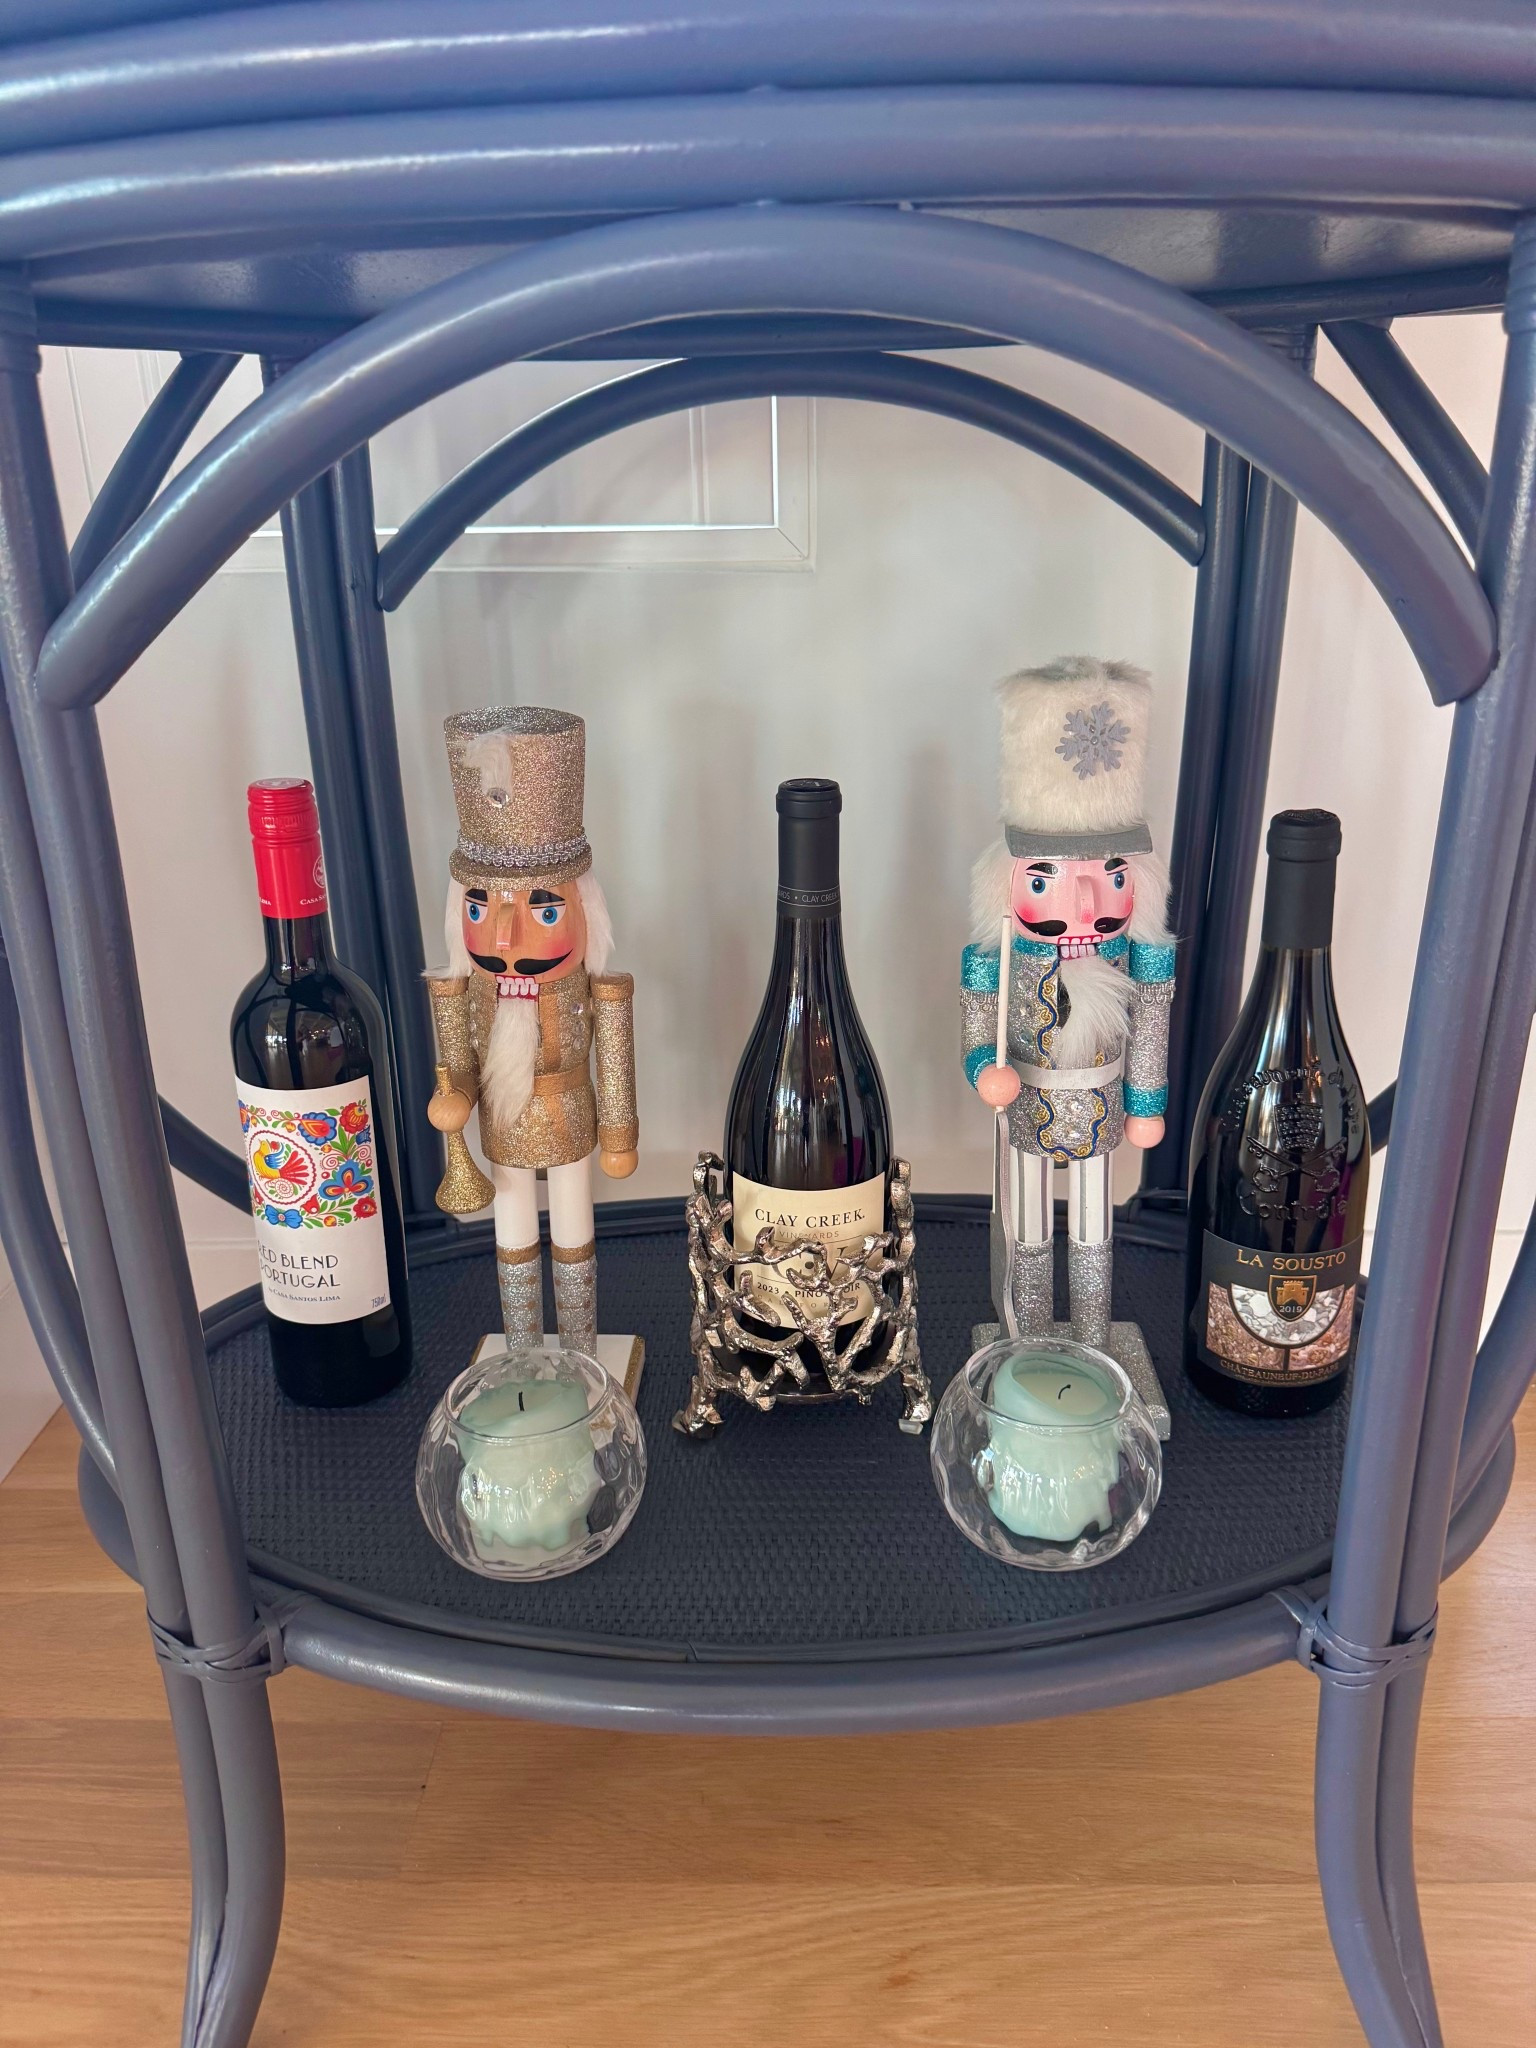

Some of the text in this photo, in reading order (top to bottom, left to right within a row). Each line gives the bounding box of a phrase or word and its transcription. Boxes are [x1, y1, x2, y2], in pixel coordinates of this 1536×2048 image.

[300, 898, 319, 906] CASA
[801, 894, 820, 903] CLAY
[755, 1208, 799, 1227] CLAY
[281, 1253, 339, 1270] BLEND
[1236, 1248, 1346, 1271] LA SOUSTO
[260, 1259, 341, 1289] PORTUGAL
[289, 1293, 318, 1302] SANTOS
[757, 1281, 780, 1295] 2023
[794, 1289, 831, 1298] PINO
[1279, 1305, 1303, 1314] 2019
